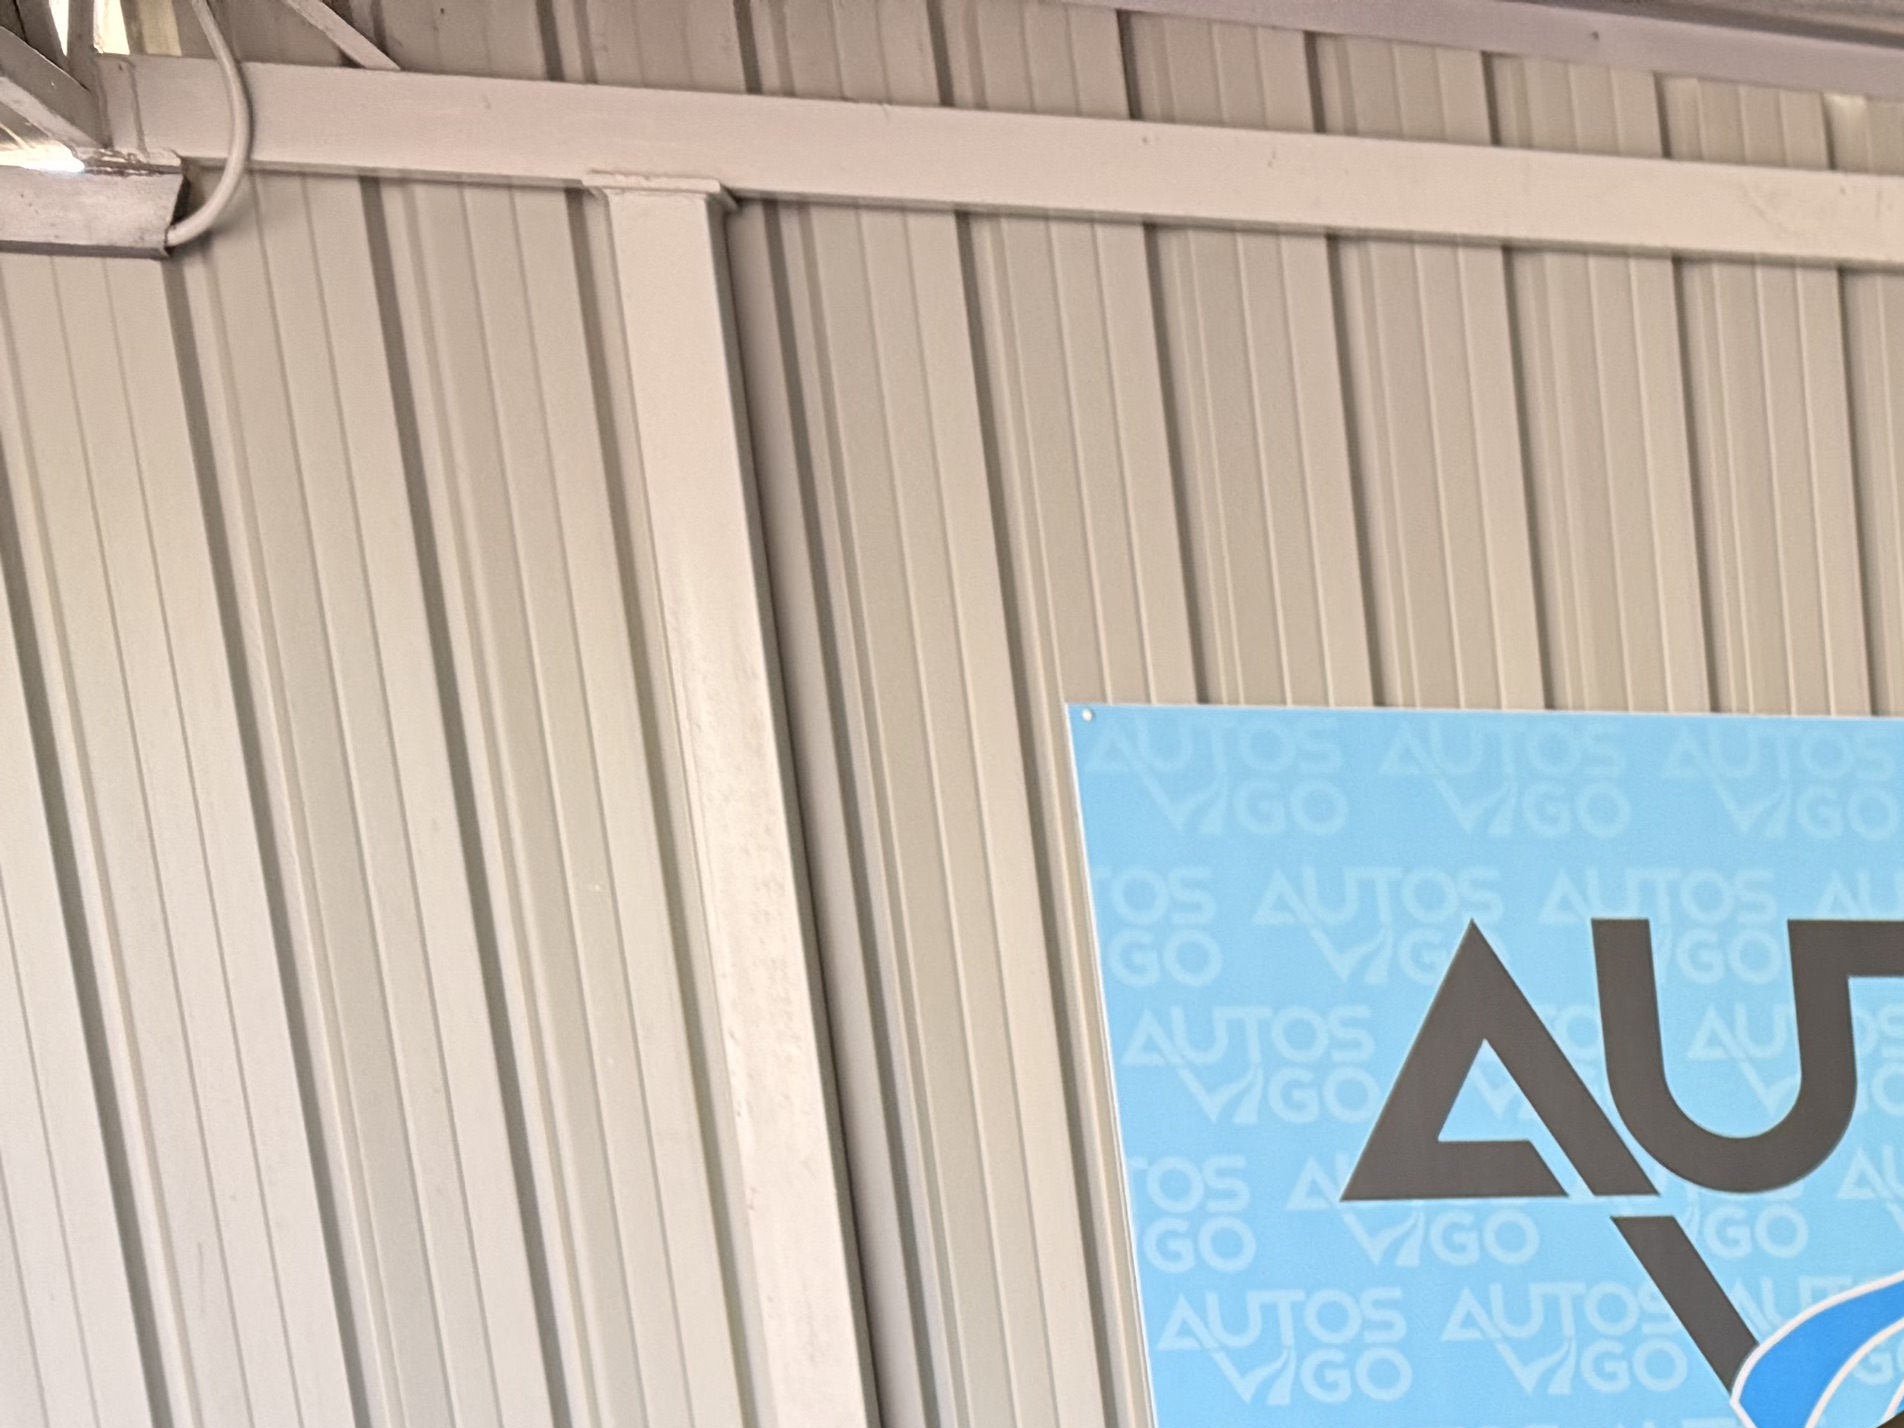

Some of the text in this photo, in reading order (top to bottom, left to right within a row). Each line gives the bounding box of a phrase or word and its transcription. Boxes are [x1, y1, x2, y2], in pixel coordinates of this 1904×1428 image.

[1086, 716, 1343, 775] AUTOS
[1379, 719, 1626, 778] AUTOS
[1661, 724, 1895, 780] AUTOS
[1142, 774, 1348, 835] VIGO
[1430, 774, 1631, 837] VIGO
[1711, 778, 1900, 841] VIGO
[1252, 867, 1500, 925] AUTOS
[1108, 928, 1222, 987] GO
[1121, 1005, 1377, 1065] AUTOS
[1176, 1064, 1381, 1124] VIGO
[1144, 1215, 1256, 1273] GO
[1342, 1206, 1540, 1267] VIGO
[1156, 1288, 1407, 1350] AUTOS
[1441, 1282, 1682, 1341] AUTOS
[1211, 1348, 1412, 1405] VIGO
[1492, 1341, 1688, 1395] VIGO
